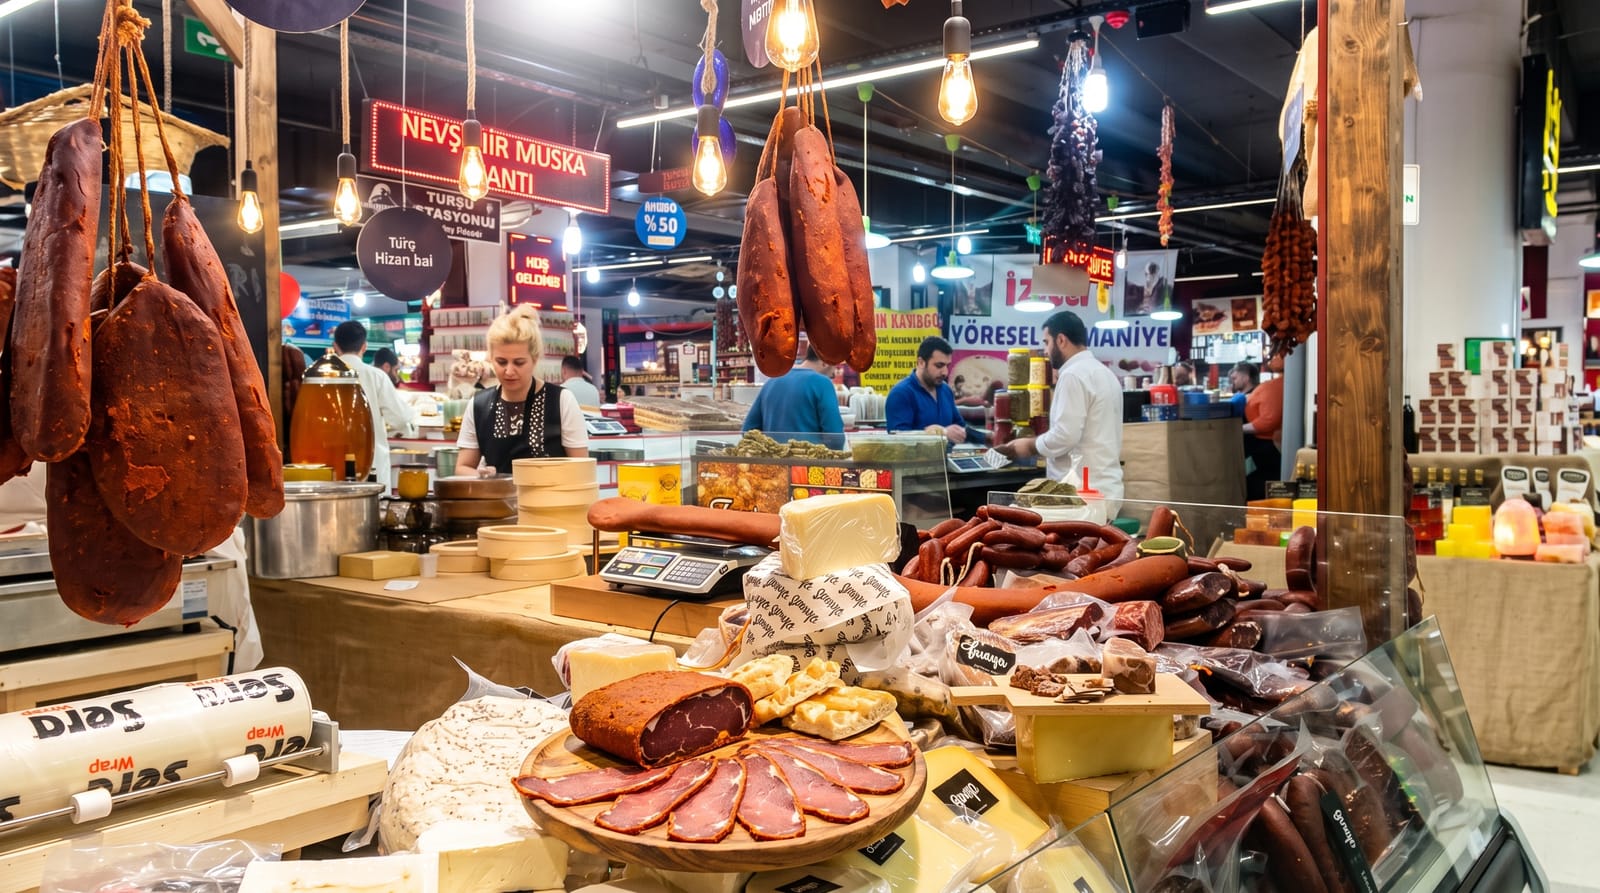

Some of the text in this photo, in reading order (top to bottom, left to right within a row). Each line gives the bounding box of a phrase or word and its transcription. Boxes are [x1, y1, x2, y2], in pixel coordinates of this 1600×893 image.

[515, 141, 587, 176] MUSKA
[487, 165, 533, 194] ANTI
[426, 191, 474, 210] TURŞU
[375, 252, 433, 267] Hizan bai
[951, 319, 1040, 346] YÖRESEL
[28, 699, 145, 739] Sera
[246, 724, 284, 740] Wrap
[89, 755, 134, 774] Wrap
